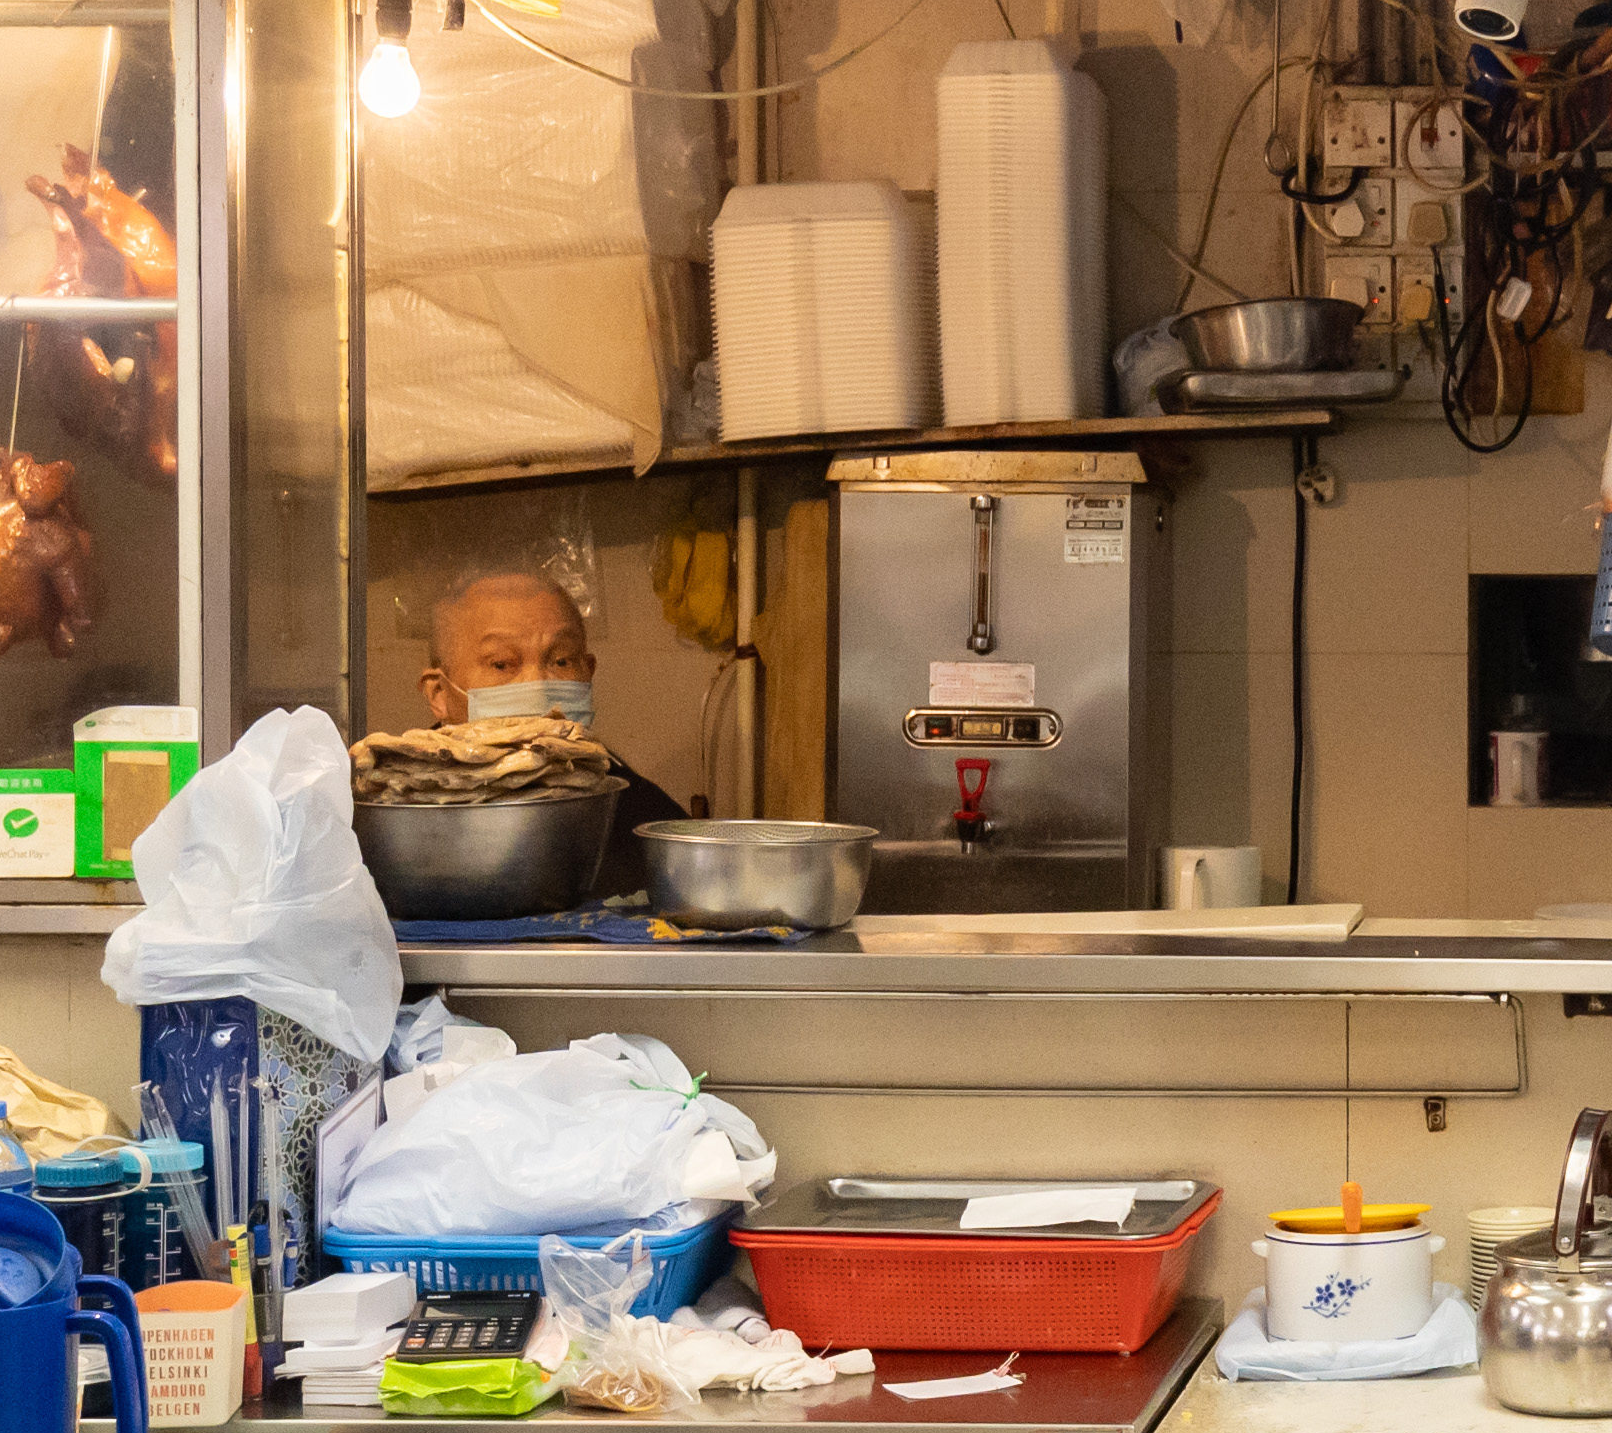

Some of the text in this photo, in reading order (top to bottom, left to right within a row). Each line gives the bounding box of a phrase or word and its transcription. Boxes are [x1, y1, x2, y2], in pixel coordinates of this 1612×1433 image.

[29, 849, 44, 861] Pay
[143, 1329, 214, 1342] PENHAGEN
[145, 1347, 214, 1360] OCKHOLM
[150, 1366, 208, 1379] ELSINKI
[151, 1384, 205, 1398] AMBURG
